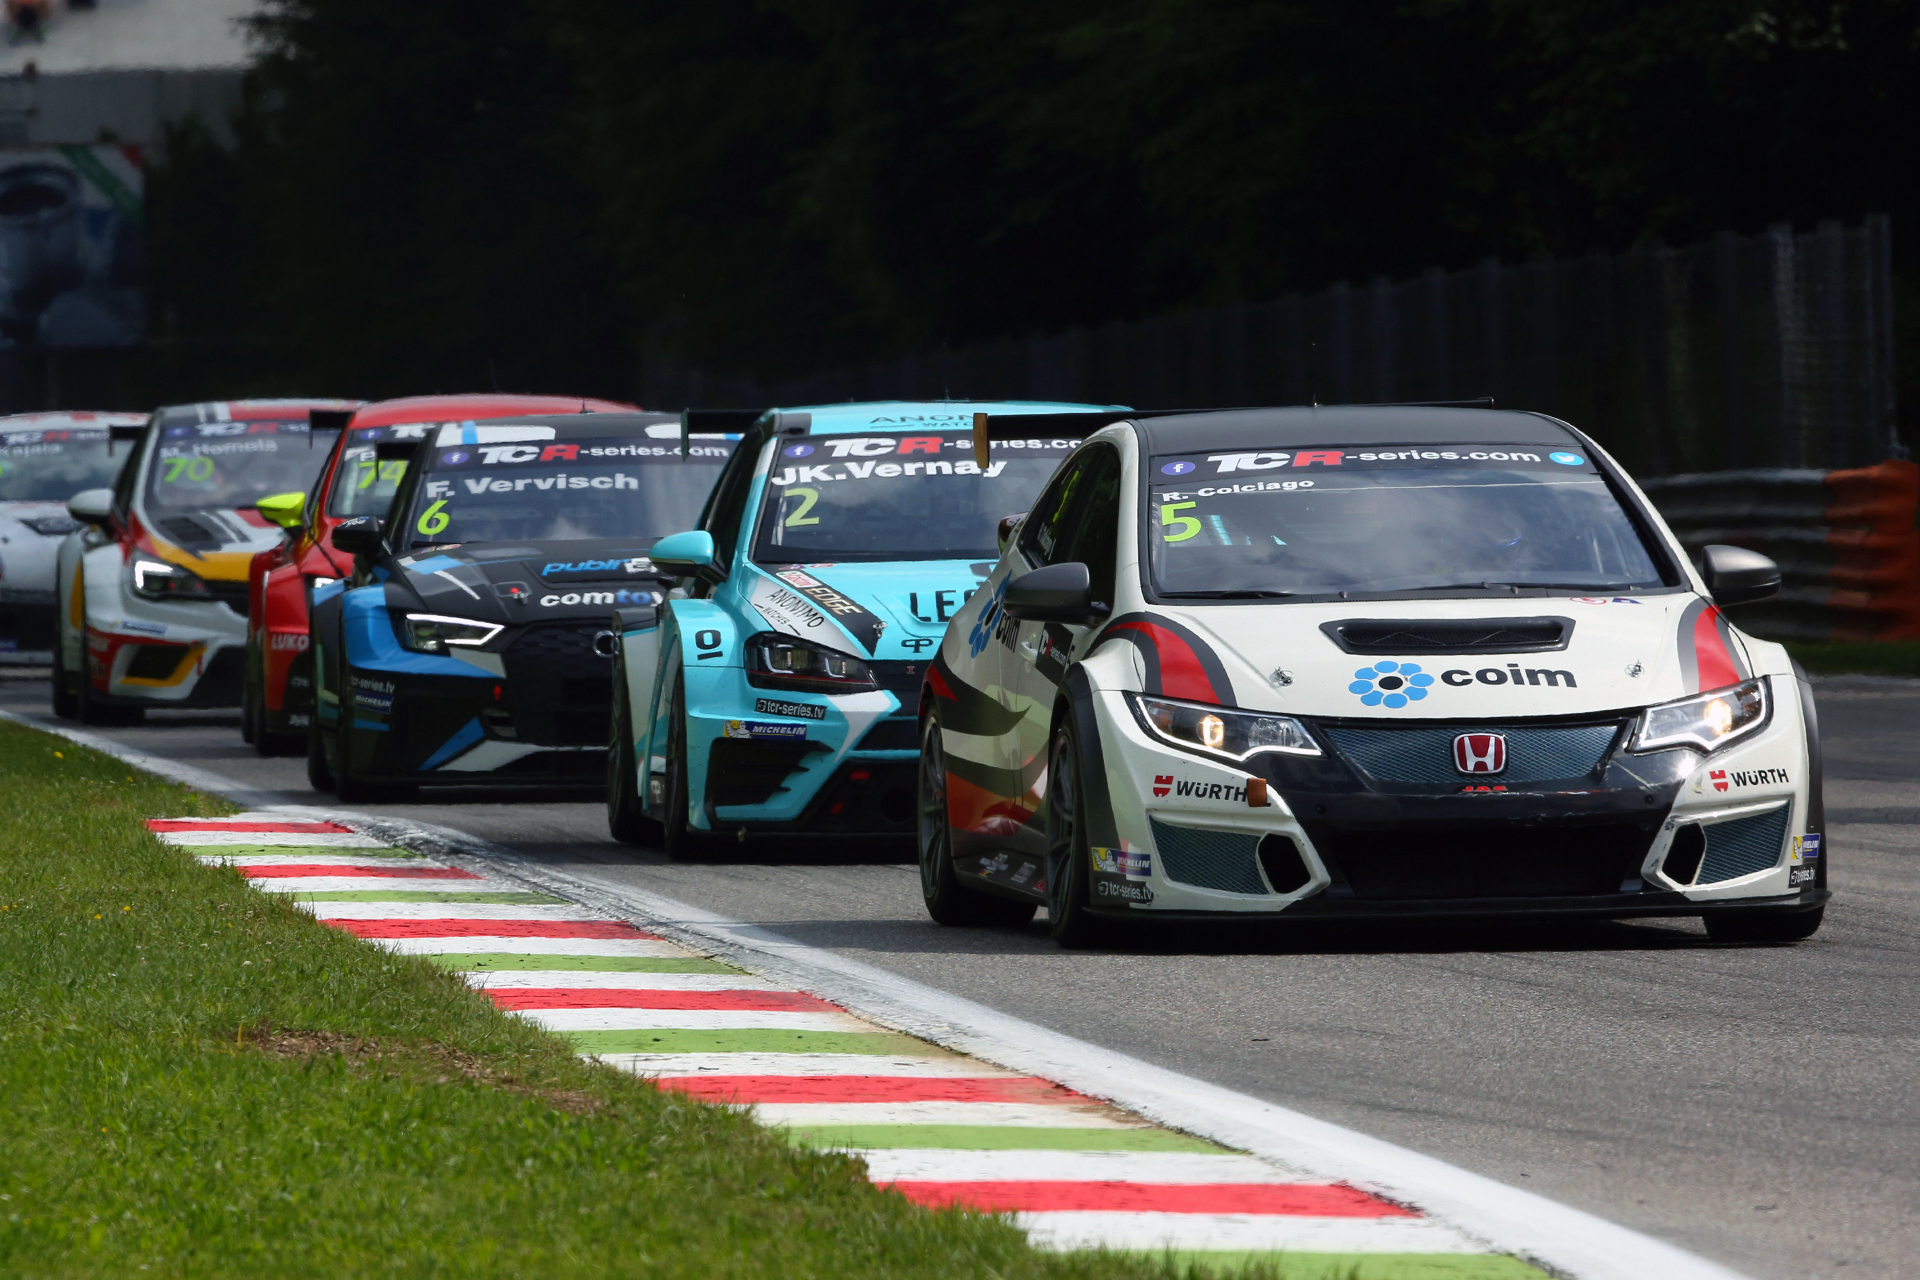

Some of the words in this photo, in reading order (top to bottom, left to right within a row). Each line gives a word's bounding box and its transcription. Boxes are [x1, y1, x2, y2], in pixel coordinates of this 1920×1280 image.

[163, 456, 216, 483] 70
[358, 460, 410, 488] 74
[771, 460, 1008, 486] JK.Vernay
[1206, 449, 1542, 473] TCR-series.com
[426, 481, 455, 498] F.
[465, 473, 640, 495] Vervisch
[1162, 491, 1189, 502] R.
[1197, 480, 1316, 498] Colciago
[416, 499, 450, 535] 6
[783, 487, 820, 527] 2
[1160, 501, 1202, 542] 5
[765, 588, 825, 628] ANONIMO
[804, 587, 864, 616] EDGE
[1440, 663, 1578, 689] coim
[767, 700, 824, 719] tcr-series.tv
[752, 725, 806, 735] MICHELIN
[1116, 855, 1151, 869] MICHELIN
[1109, 880, 1154, 901] tcr-series.tv
